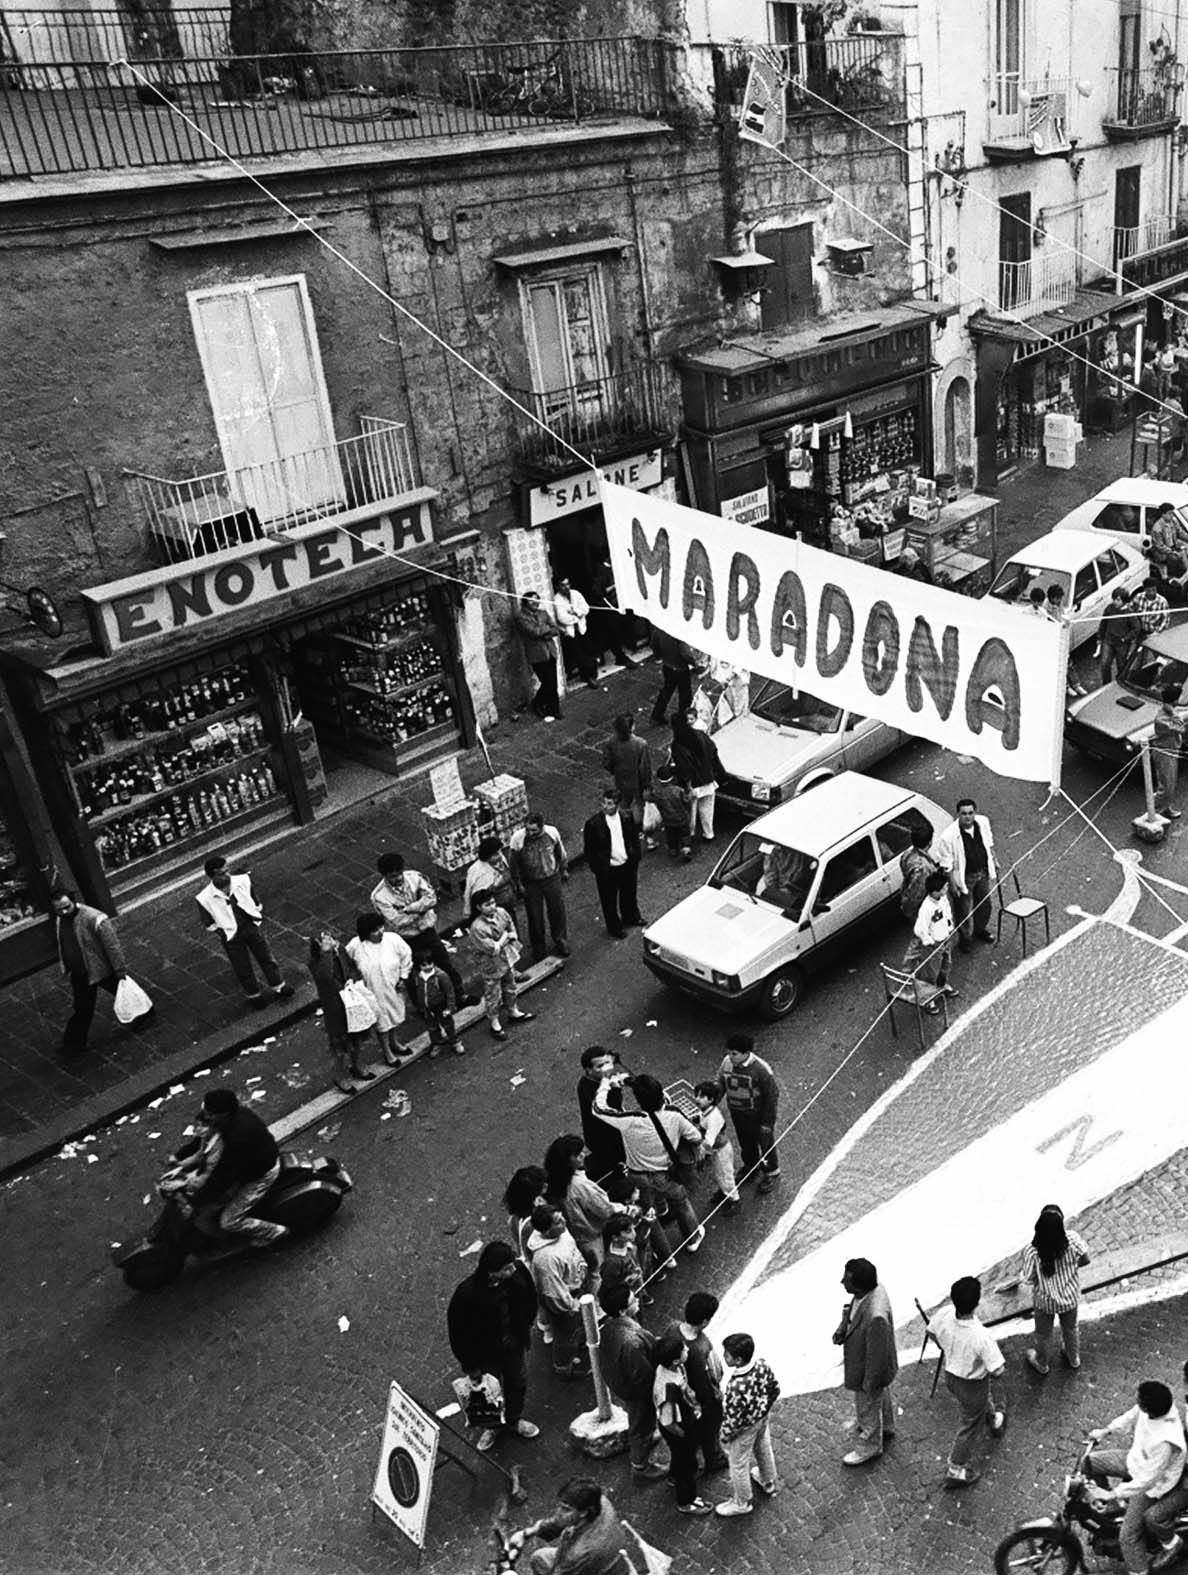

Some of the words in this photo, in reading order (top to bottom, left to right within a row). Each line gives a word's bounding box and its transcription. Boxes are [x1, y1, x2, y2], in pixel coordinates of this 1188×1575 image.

[110, 503, 428, 643] ENOTECA
[632, 517, 1021, 751] MARADONA
[1034, 1113, 1125, 1171] N
